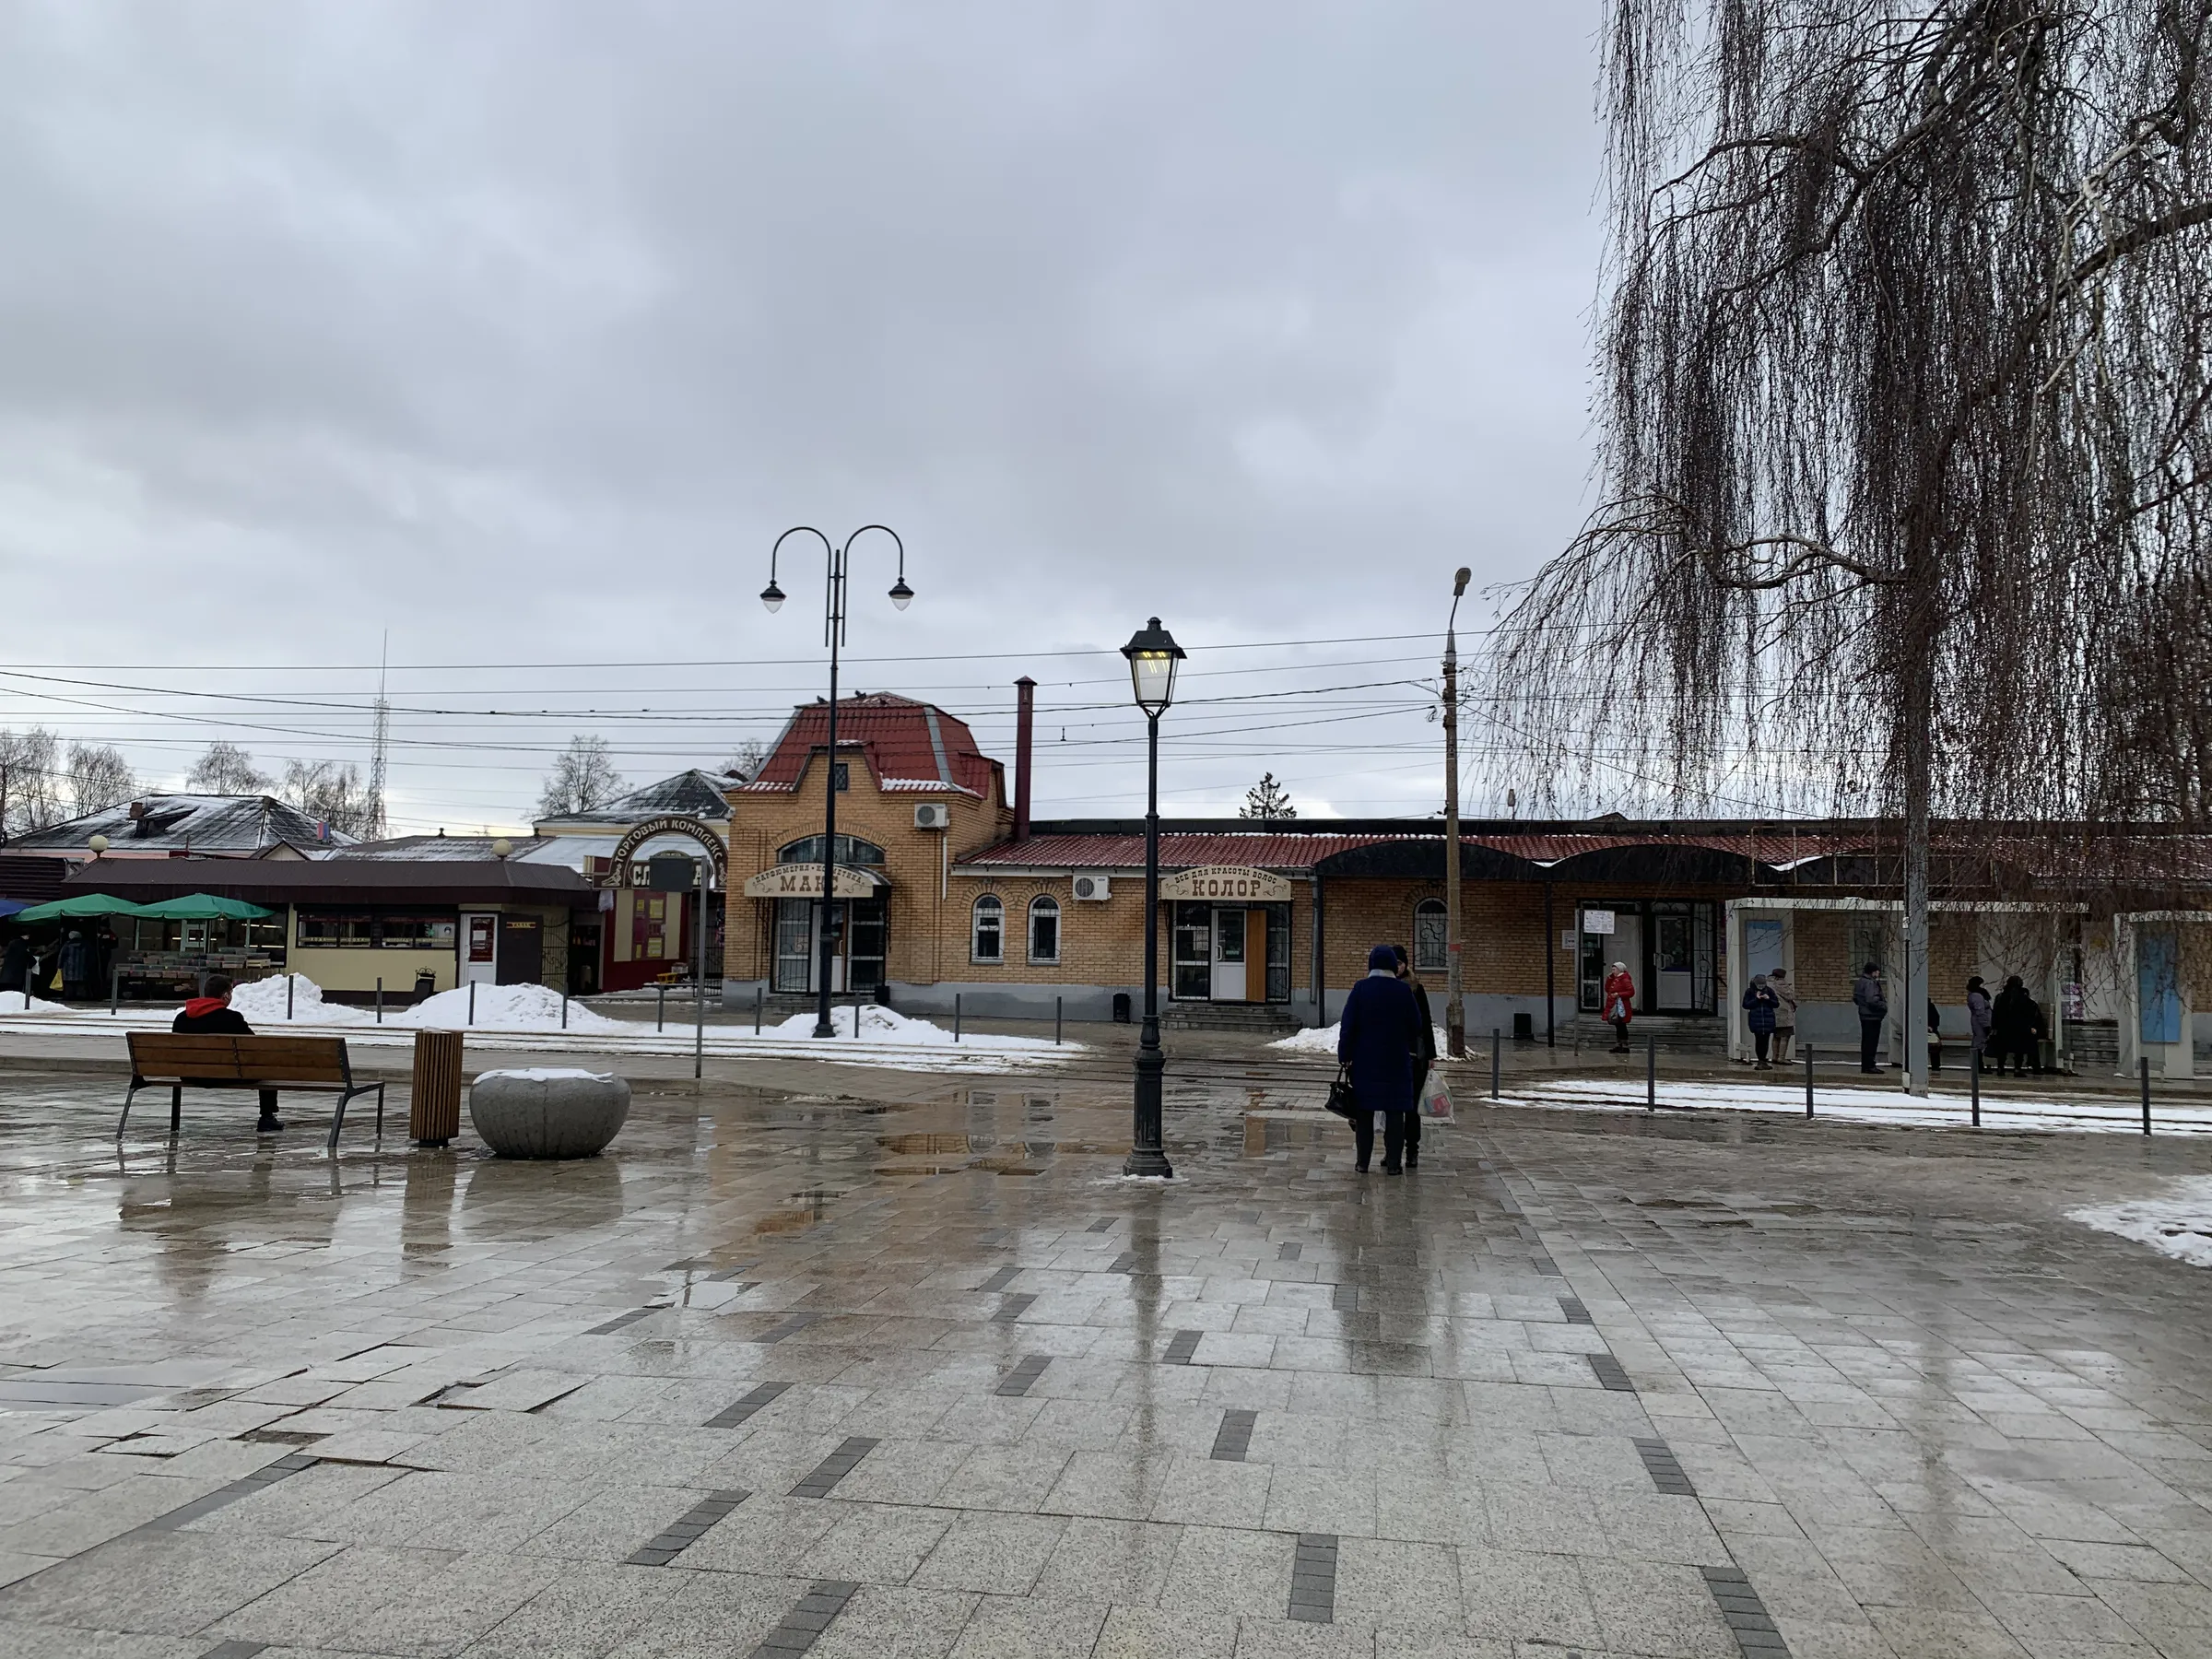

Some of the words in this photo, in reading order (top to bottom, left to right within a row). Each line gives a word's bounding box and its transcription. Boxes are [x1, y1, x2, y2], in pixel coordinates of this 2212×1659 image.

[615, 818, 668, 863] ТОРГОВЫЙ
[671, 819, 724, 860] КОМПЛЕКС
[755, 865, 809, 884] ПАРФЮМЕРИЯ
[816, 866, 862, 885] КОМЕТИКА
[780, 876, 839, 892] МАКС
[1174, 873, 1190, 884] ВСЕ
[1191, 868, 1209, 879] ДЛЯ
[1211, 867, 1251, 877] КРАСОТЫ
[1252, 870, 1277, 885] ВОЛОС
[1192, 879, 1261, 897] КОЛОР
